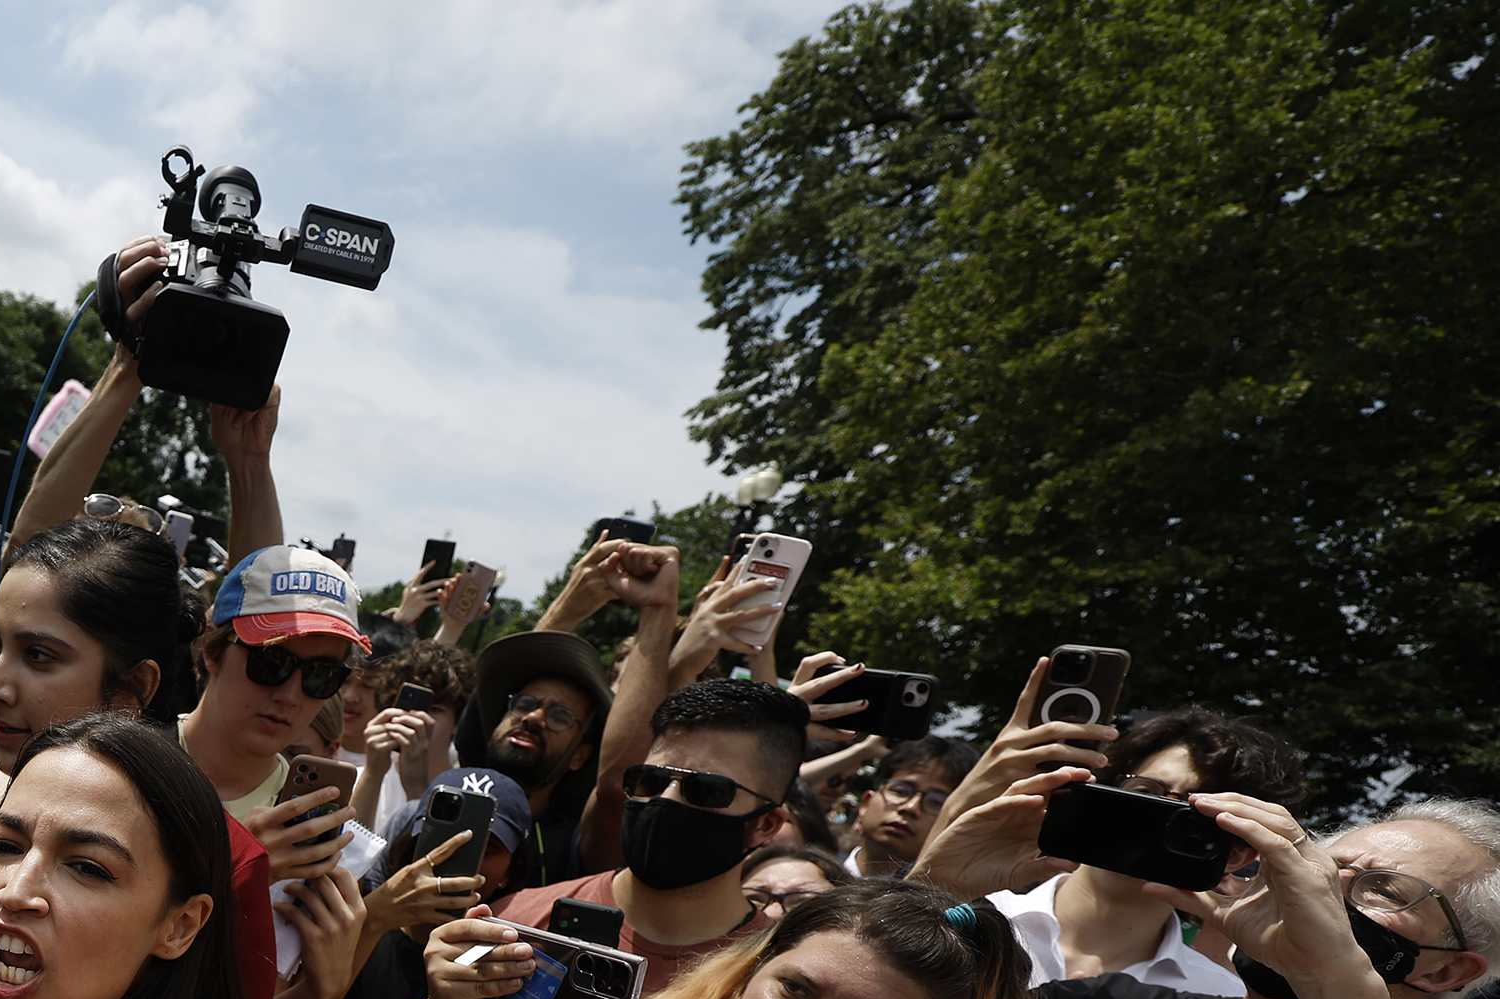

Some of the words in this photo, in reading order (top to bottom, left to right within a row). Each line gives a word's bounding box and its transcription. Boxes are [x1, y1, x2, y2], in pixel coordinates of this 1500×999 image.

[303, 242, 328, 254] CREATED
[328, 247, 337, 256] BY
[335, 249, 354, 260] CABLE
[353, 253, 361, 261] IN
[360, 255, 375, 264] 1979
[275, 571, 312, 592] OLD
[315, 573, 345, 598] BAY
[461, 772, 495, 795] NY
